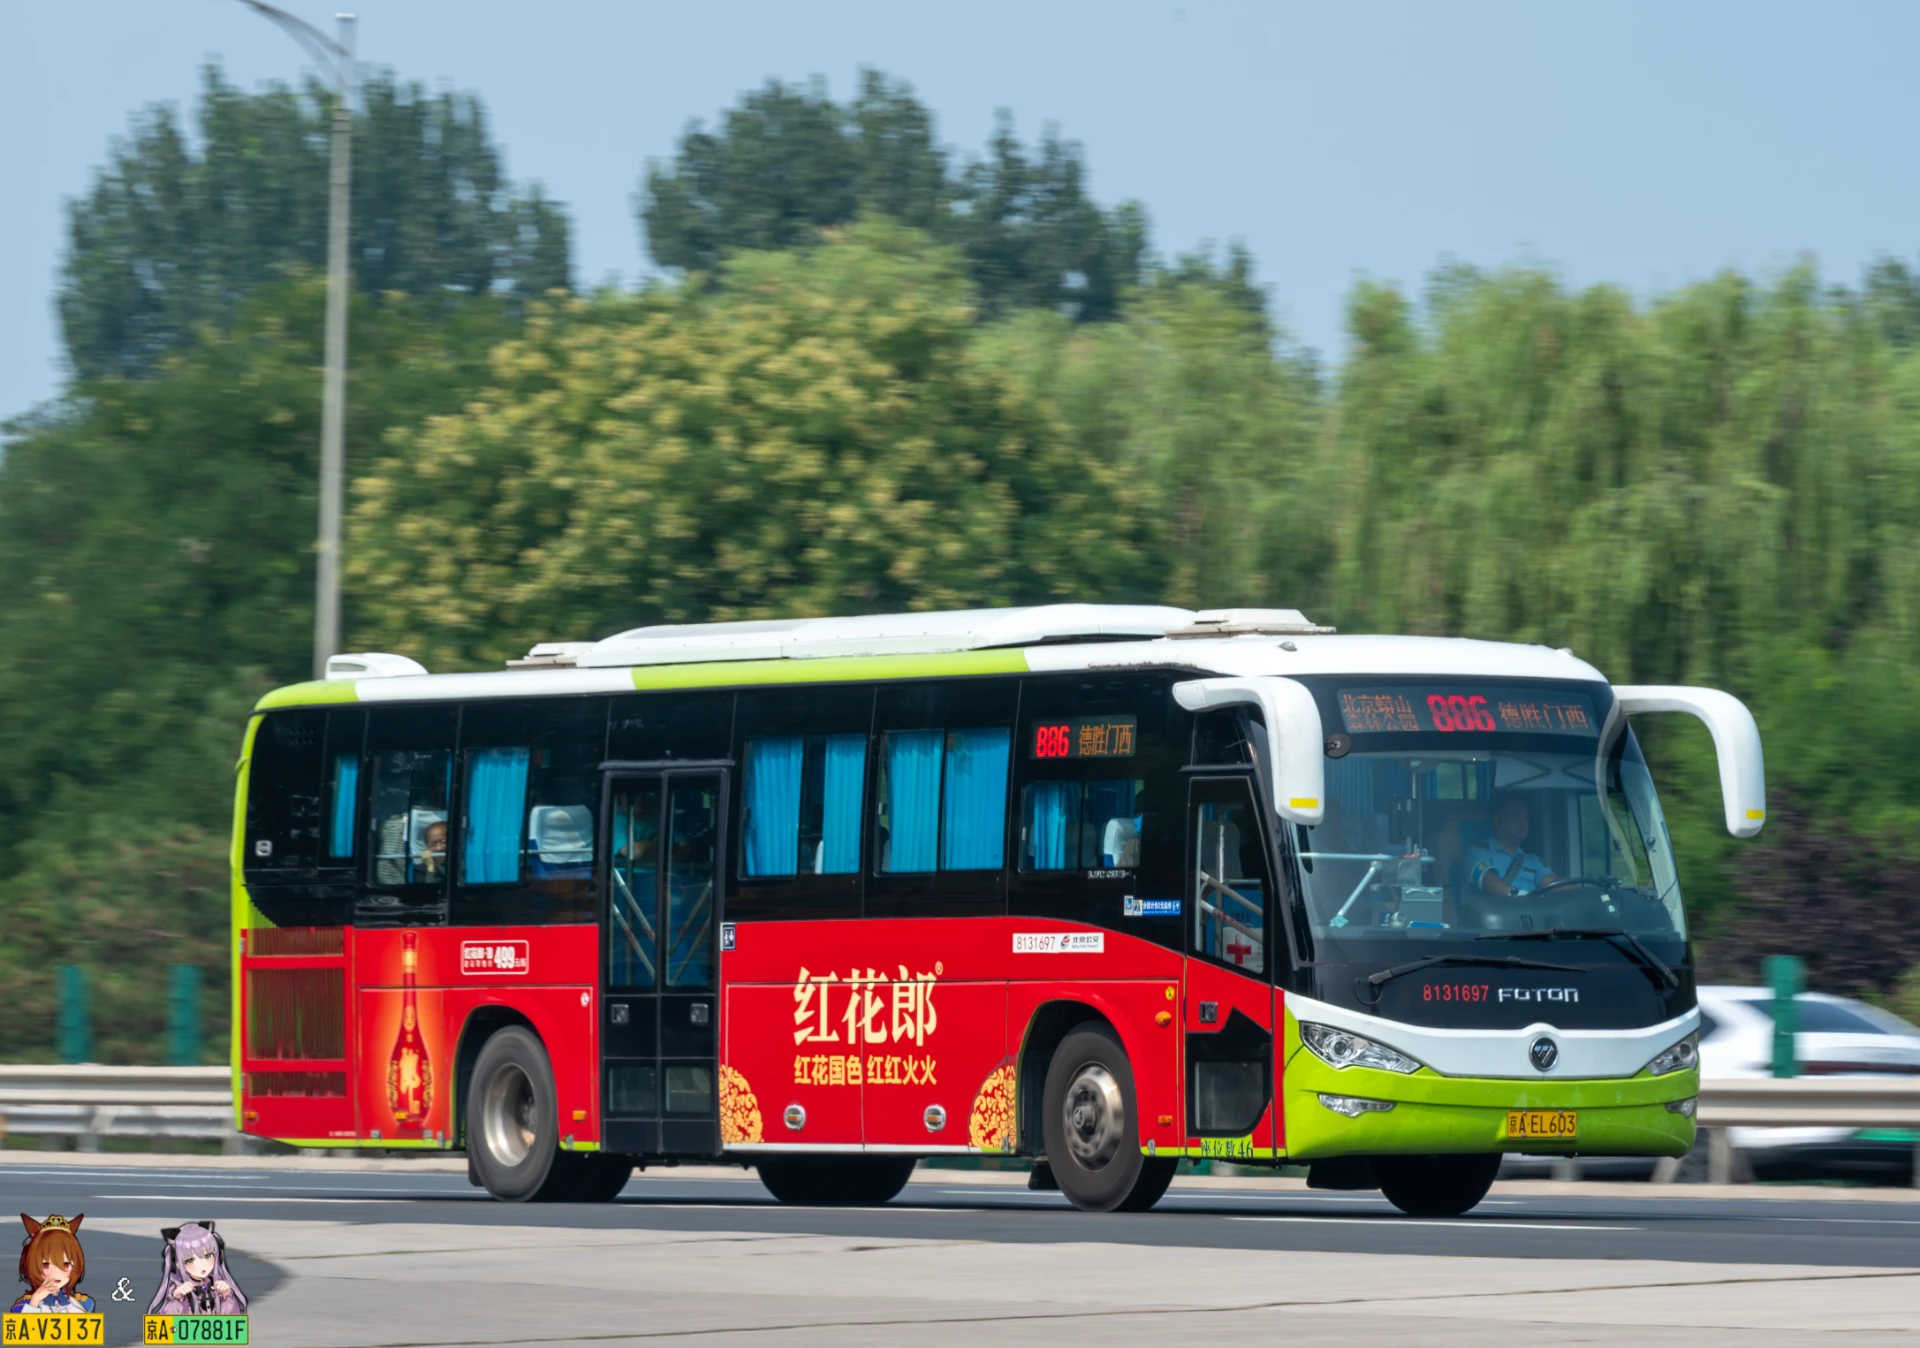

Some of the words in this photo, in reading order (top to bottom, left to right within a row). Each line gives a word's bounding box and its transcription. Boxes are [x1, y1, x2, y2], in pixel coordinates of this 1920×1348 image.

[1342, 693, 1412, 713] 北京蟒山
[1427, 694, 1496, 732] 886
[1499, 701, 1589, 730] 德胜门西
[1346, 713, 1420, 732] 森林公园
[1035, 725, 1070, 758] 886
[1078, 723, 1134, 756] 德胜门西
[1016, 936, 1056, 950] 8131697
[494, 946, 515, 969] 499
[1423, 984, 1489, 1001] 8131697
[793, 1054, 862, 1086] 红花国色
[866, 1054, 937, 1086] 红红火火
